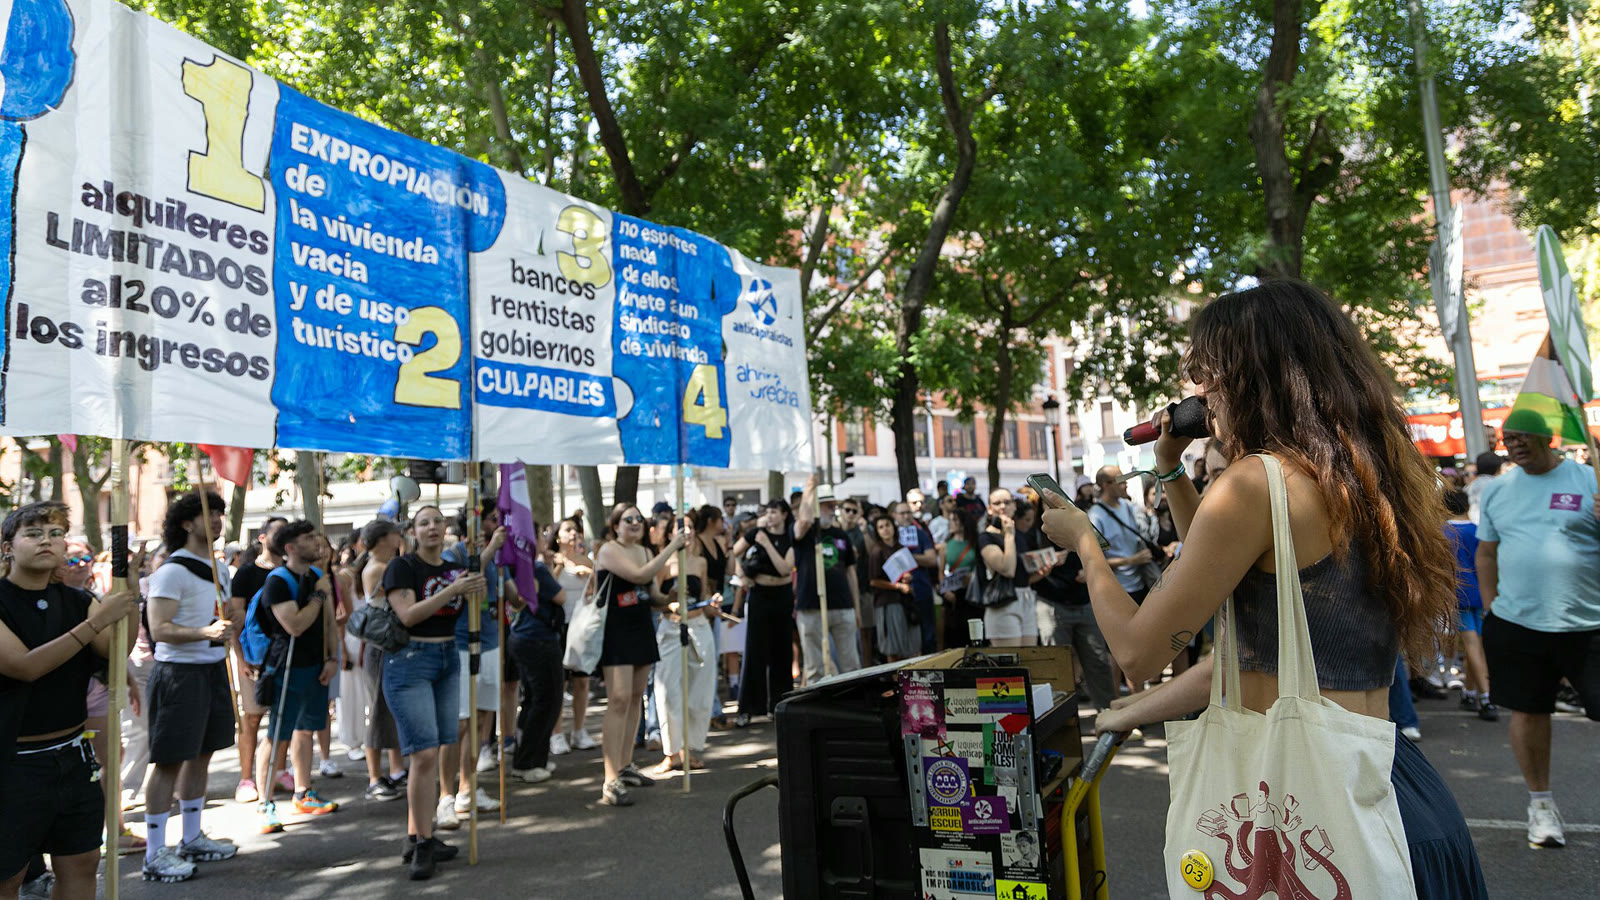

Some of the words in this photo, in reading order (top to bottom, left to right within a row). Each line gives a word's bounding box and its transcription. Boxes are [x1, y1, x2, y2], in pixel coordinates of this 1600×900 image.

[181, 54, 265, 213] 1
[285, 163, 327, 197] de
[291, 121, 489, 217] EXPROPIACIÓN
[81, 180, 269, 255] alquileres
[289, 197, 318, 232] la
[322, 214, 439, 265] vivienda
[46, 211, 269, 296] LIMITADOS
[556, 205, 612, 289] 3
[619, 220, 639, 239] no
[641, 227, 698, 256] esperes
[620, 244, 657, 266] nada
[511, 258, 596, 301] bancos
[622, 264, 639, 284] de
[225, 302, 272, 338] de
[289, 281, 309, 311] y
[315, 284, 353, 315] de
[359, 298, 410, 326] uso
[491, 294, 596, 333] rentistas
[16, 302, 84, 350] los
[96, 320, 270, 381] ingresos
[394, 306, 462, 409] 2
[480, 329, 595, 368] gobiernos
[620, 336, 641, 356] de
[477, 366, 606, 407] CULPABLES
[682, 364, 727, 439] 4
[954, 706, 978, 715] anticap
[959, 750, 983, 759] anticap
[984, 754, 1016, 768] PALEST
[1185, 863, 1203, 882] 0-3
